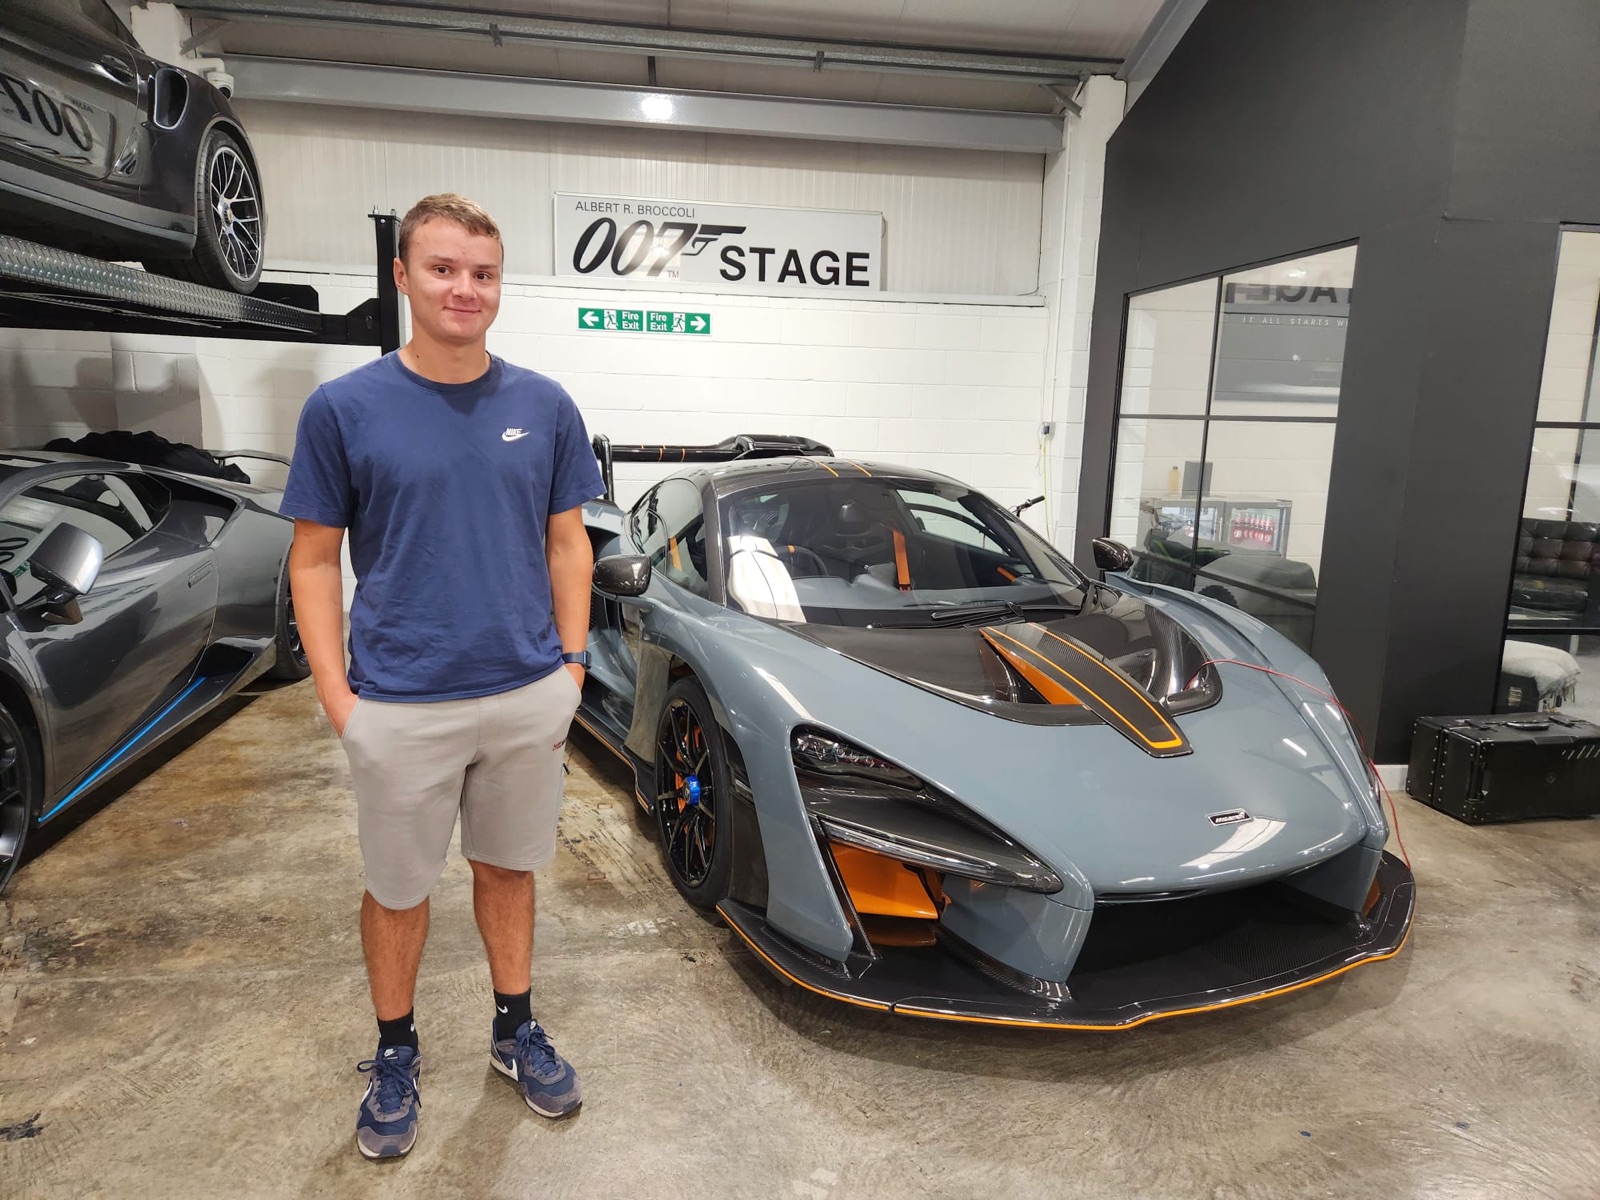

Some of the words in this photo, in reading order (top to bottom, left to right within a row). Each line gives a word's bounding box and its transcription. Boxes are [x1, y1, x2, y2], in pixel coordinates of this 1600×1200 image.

[575, 201, 620, 213] ALBERT
[623, 203, 634, 214] R.
[637, 204, 695, 218] BROCCOLI
[573, 217, 698, 276] 007
[720, 245, 869, 286] STAGE
[668, 270, 679, 278] TM
[622, 311, 639, 320] Fire
[650, 312, 667, 322] Fire
[622, 320, 639, 330] Exit
[650, 321, 667, 331] Exit
[1290, 318, 1329, 326] STARTS
[505, 428, 522, 436] NIKE
